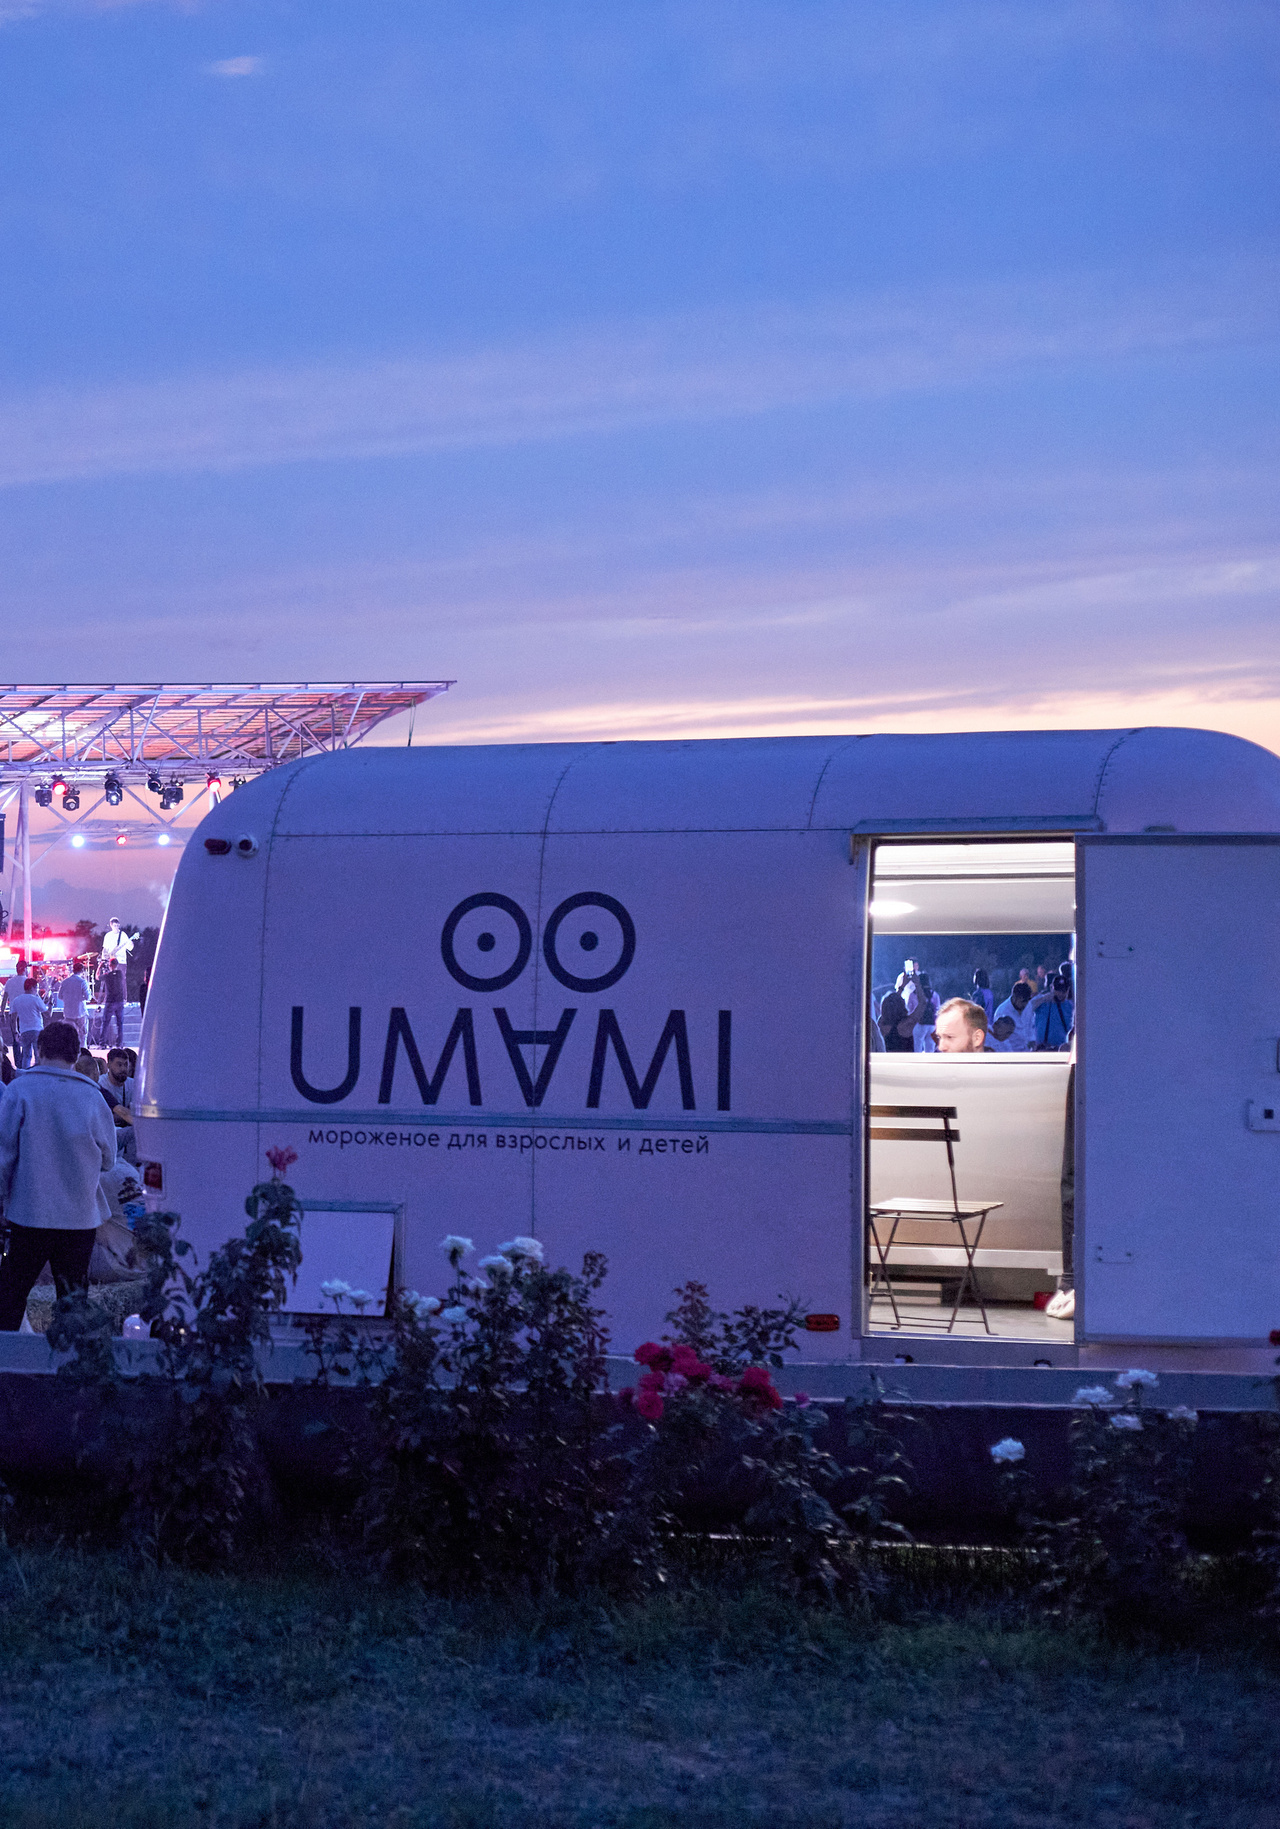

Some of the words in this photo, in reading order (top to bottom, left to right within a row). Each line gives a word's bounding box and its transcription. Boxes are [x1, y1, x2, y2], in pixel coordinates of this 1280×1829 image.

[289, 1005, 733, 1111] UMAMI
[308, 1129, 440, 1150] мороженое
[447, 1131, 488, 1150] для
[495, 1134, 605, 1153] взрослых
[617, 1138, 632, 1152] и
[640, 1136, 710, 1155] детей
